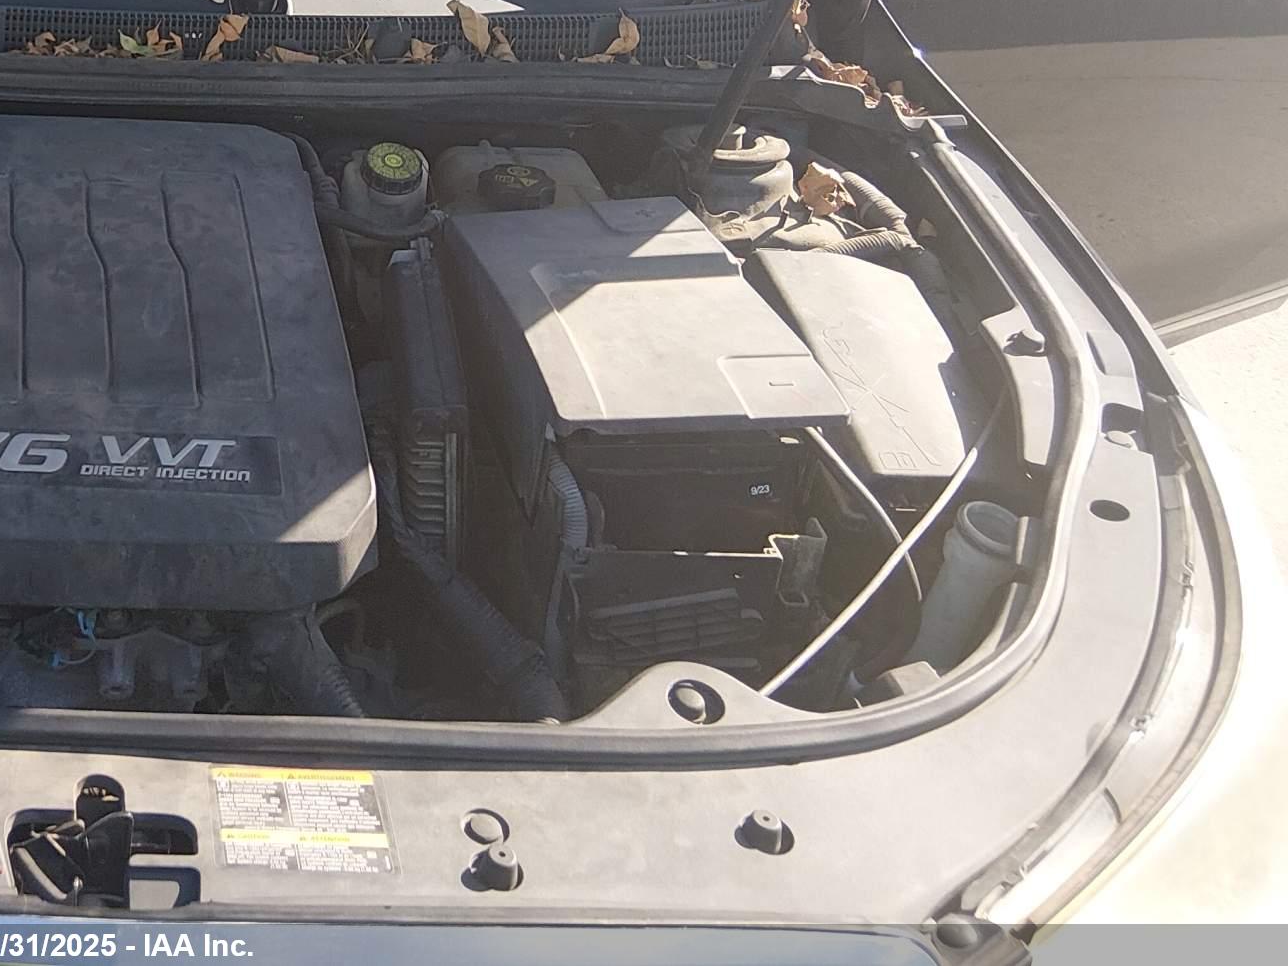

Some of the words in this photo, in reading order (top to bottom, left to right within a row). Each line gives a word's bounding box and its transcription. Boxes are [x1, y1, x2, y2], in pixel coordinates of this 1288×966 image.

[102, 435, 236, 468] VVT
[80, 465, 150, 479] DIRECT
[156, 467, 250, 482] INJECTION
[750, 484, 770, 495] 9/23
